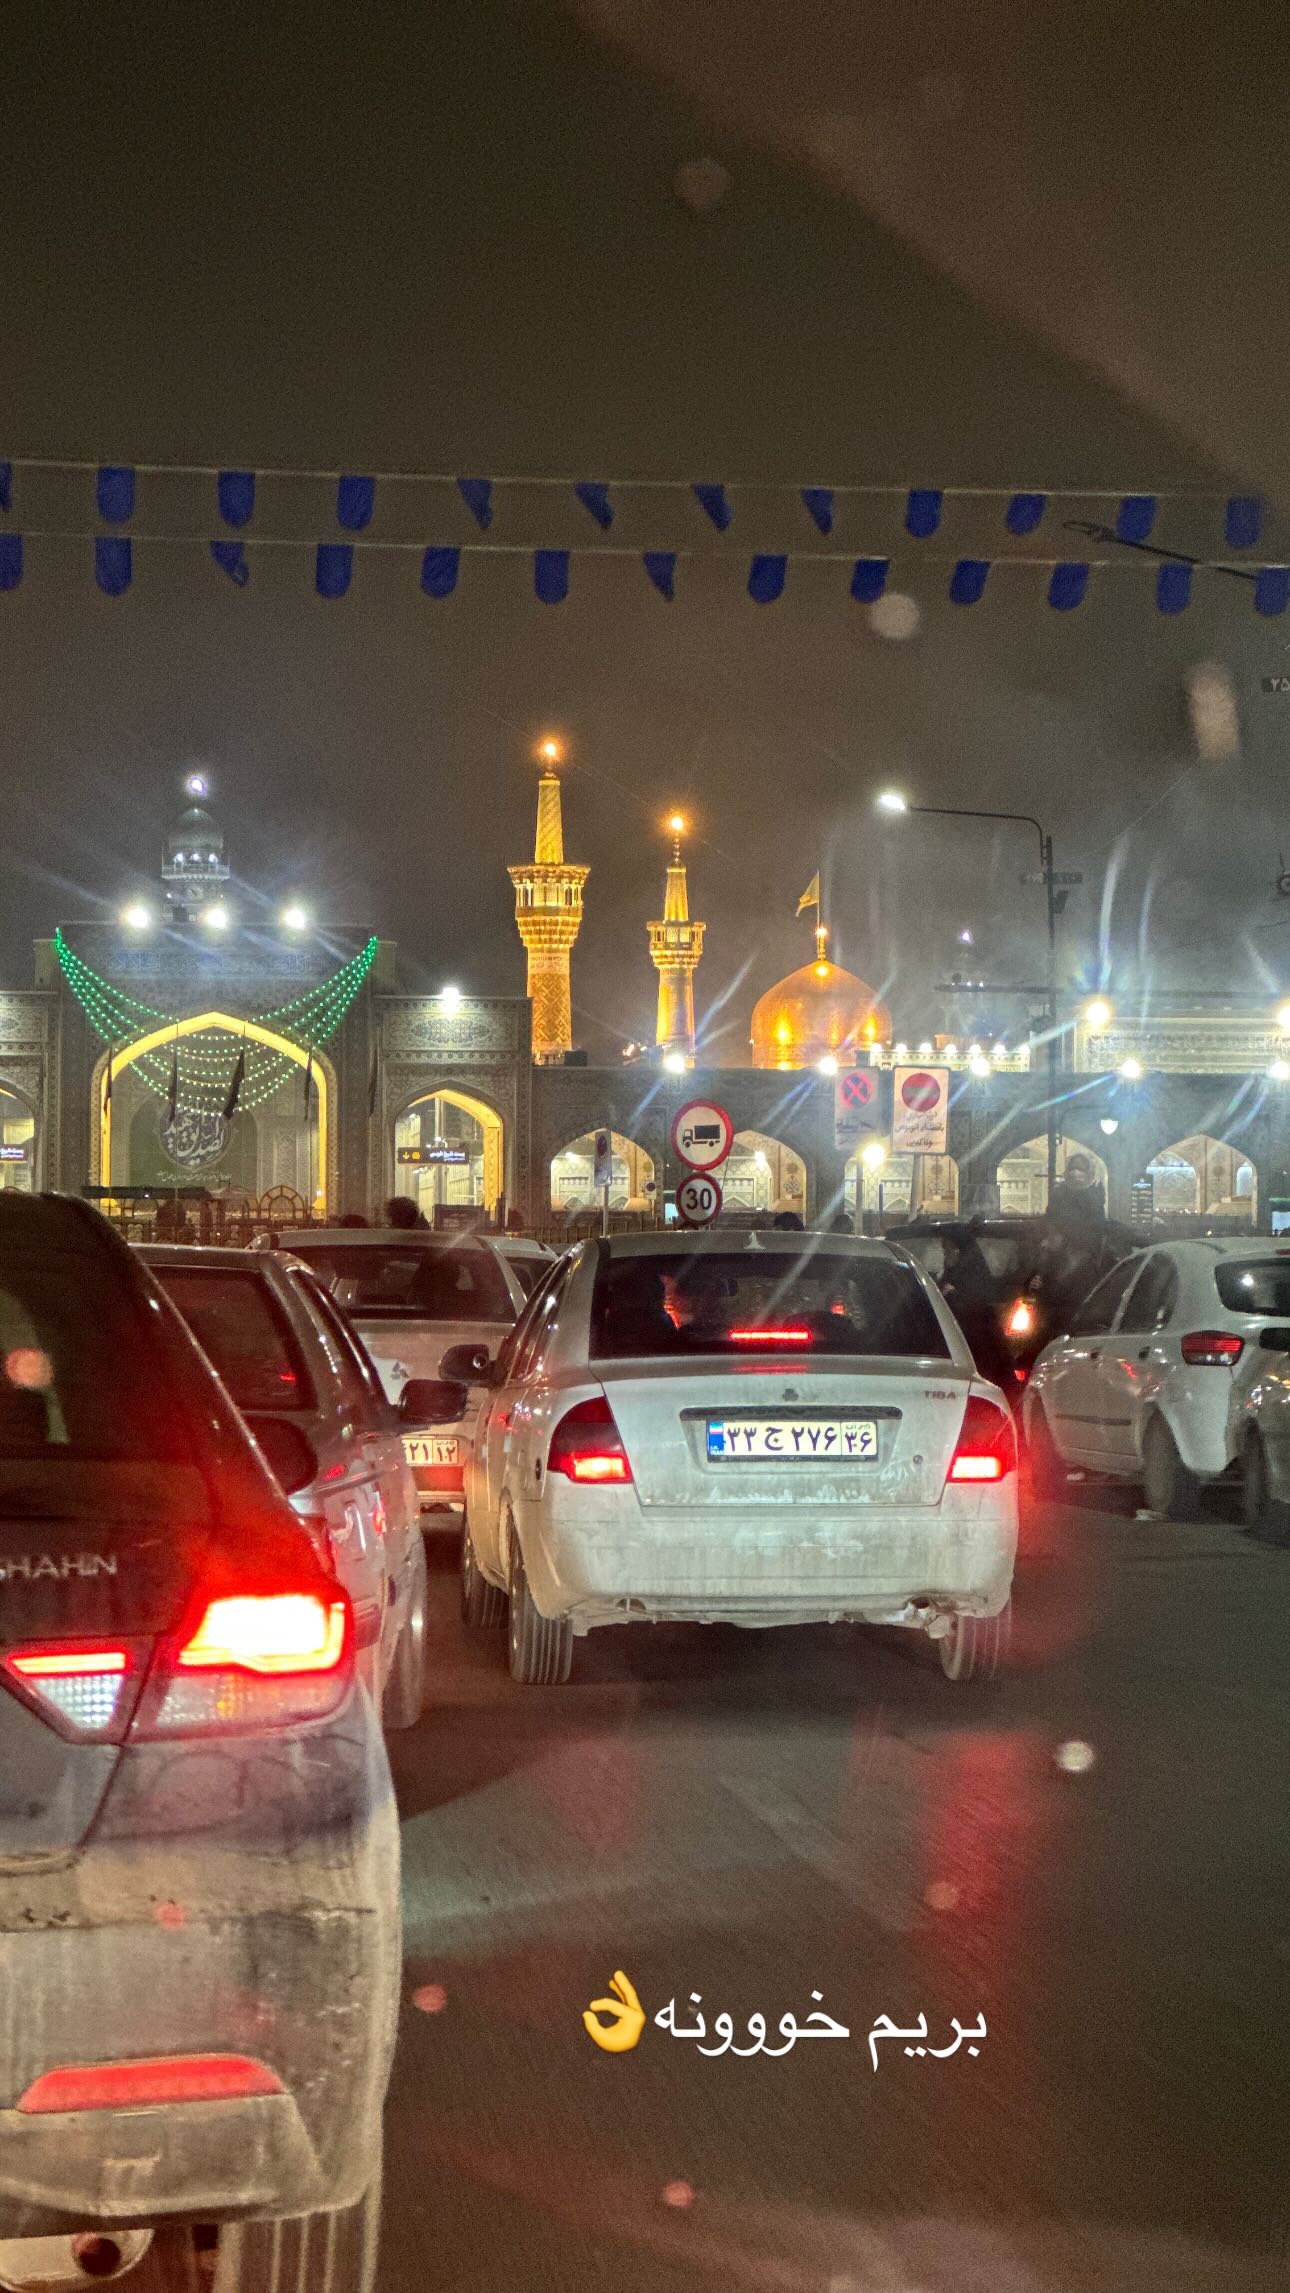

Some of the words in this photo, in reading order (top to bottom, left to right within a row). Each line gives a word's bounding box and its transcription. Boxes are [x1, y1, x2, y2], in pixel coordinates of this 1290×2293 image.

[686, 1188, 712, 1210] 30
[923, 1390, 957, 1400] TIBA
[727, 1427, 757, 1452] ۳۳
[764, 1426, 784, 1451] ج
[791, 1426, 838, 1452] ۲۷۶
[844, 1431, 873, 1453] ۳۶
[437, 1446, 456, 1462] ۱۲
[0, 1553, 118, 1579] HAHIN
